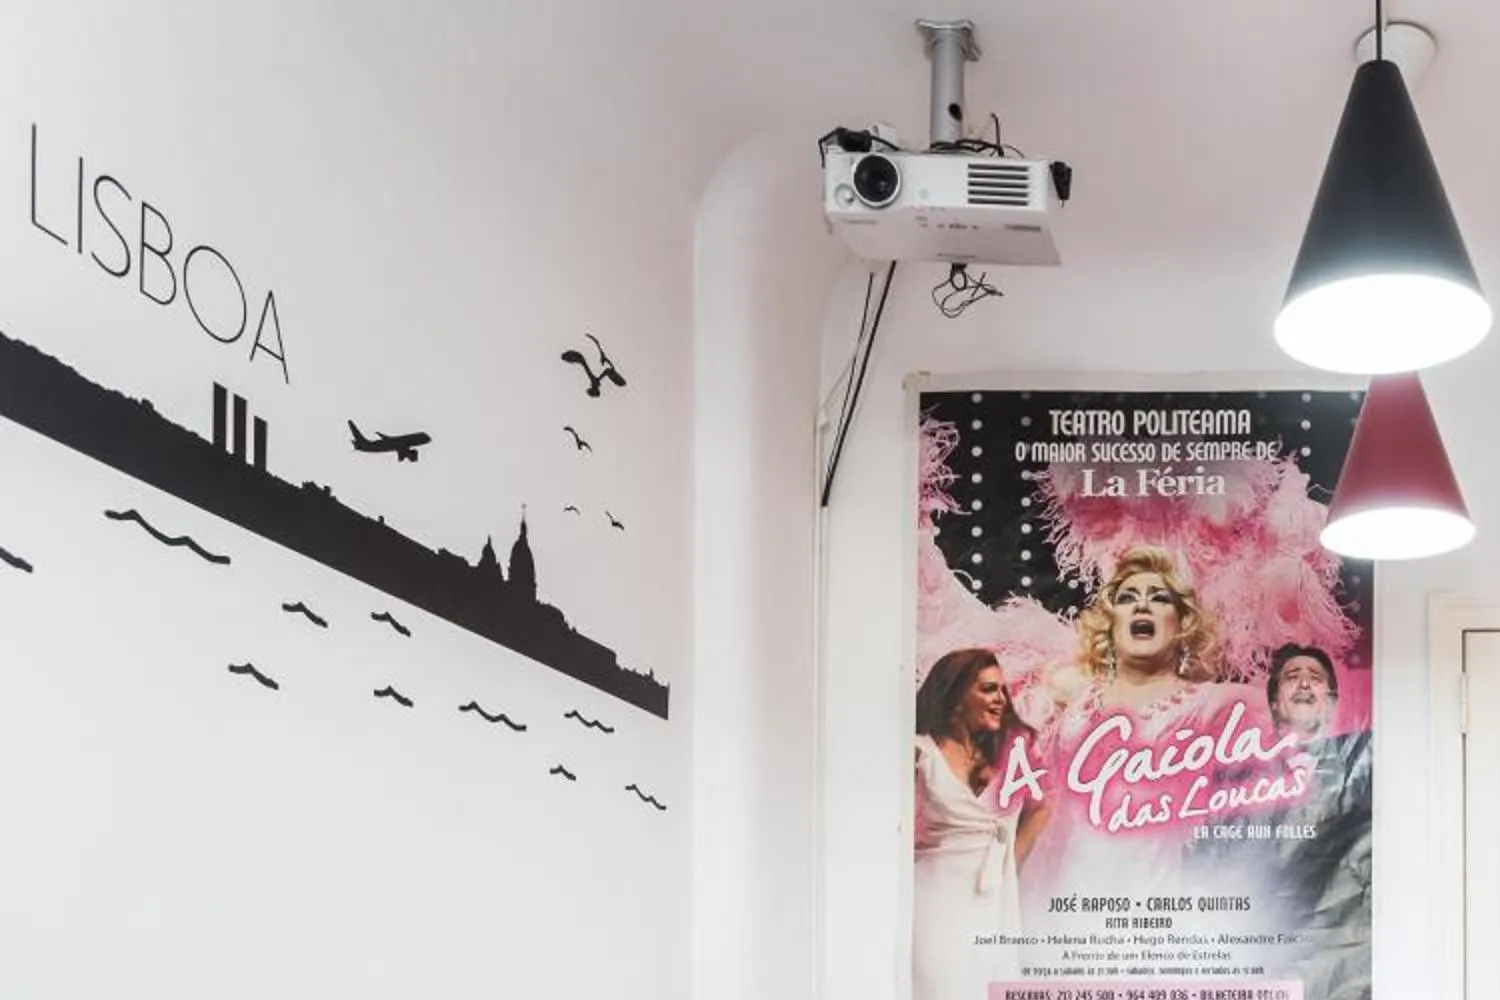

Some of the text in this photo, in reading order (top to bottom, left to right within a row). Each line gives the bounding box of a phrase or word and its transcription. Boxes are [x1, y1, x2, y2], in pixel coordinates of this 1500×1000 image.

[31, 122, 290, 384] LISBOA
[1049, 409, 1251, 436] TEATRO POLITEAMA
[1015, 440, 1278, 464] O MAIOR SUCESSO DE SEMPRE DE
[1080, 465, 1226, 498] La Féria
[999, 702, 1299, 827] A Gaiola
[1107, 768, 1310, 833] das Loucas
[1048, 892, 1252, 913] JOSÉ RAPOSO CARLOS QUINTAS
[1105, 917, 1173, 930] RITA RIBEIRO
